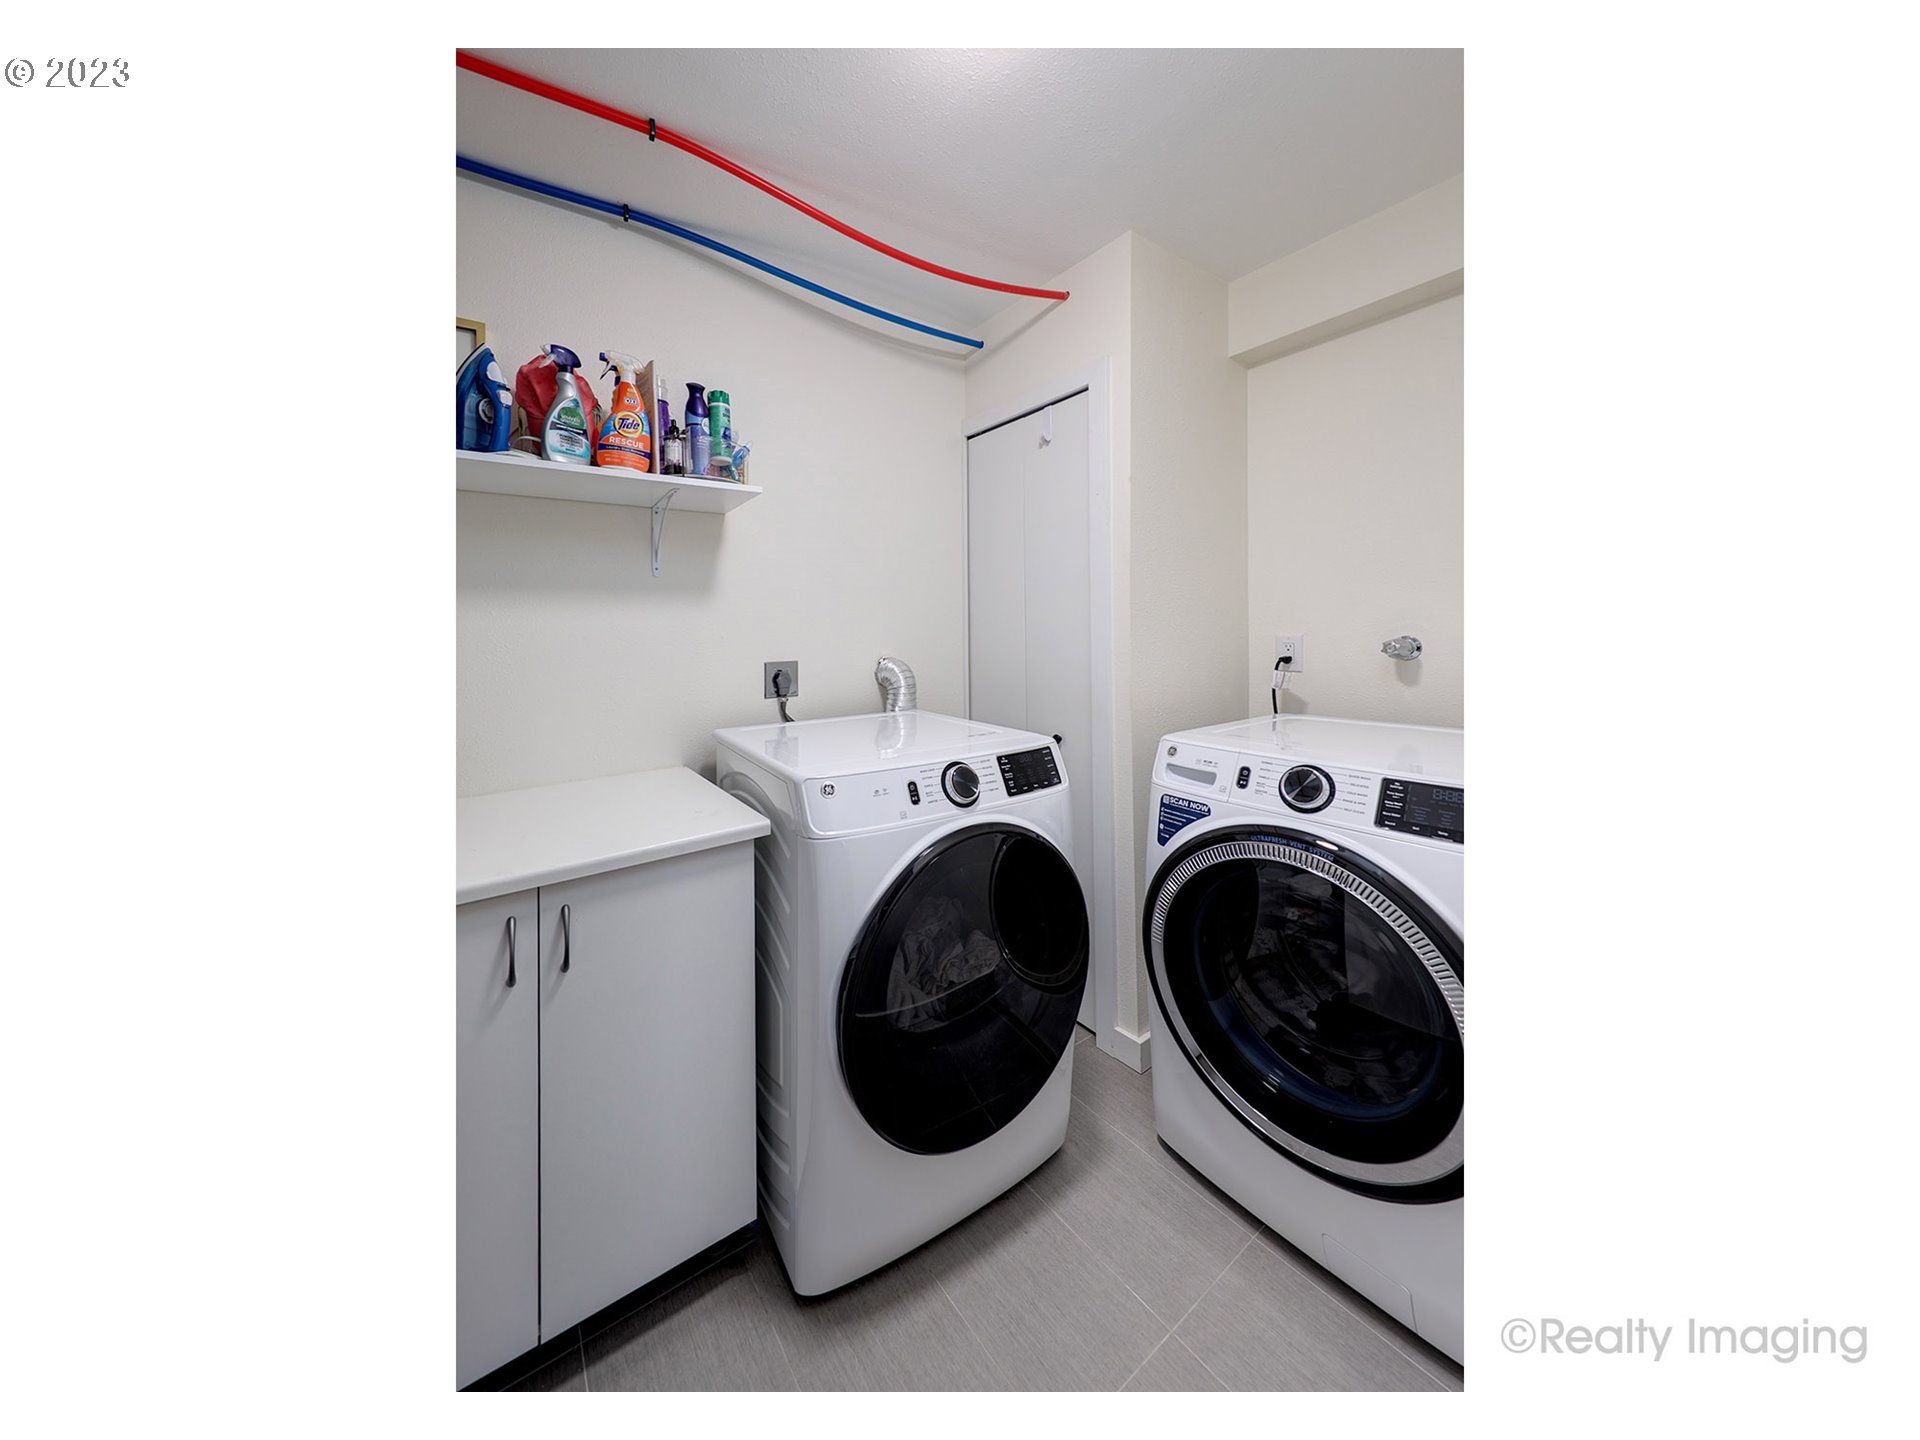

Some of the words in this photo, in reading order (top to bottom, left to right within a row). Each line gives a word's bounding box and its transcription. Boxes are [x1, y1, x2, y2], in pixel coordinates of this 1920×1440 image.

[618, 417, 640, 431] Tide
[608, 436, 645, 449] RESCUE
[1169, 796, 1189, 808] SCAN
[1189, 801, 1210, 813] NOW
[1250, 834, 1288, 845] ULTRAFRESH
[1289, 840, 1306, 850] VENT
[1308, 847, 1335, 861] SYSTEM
